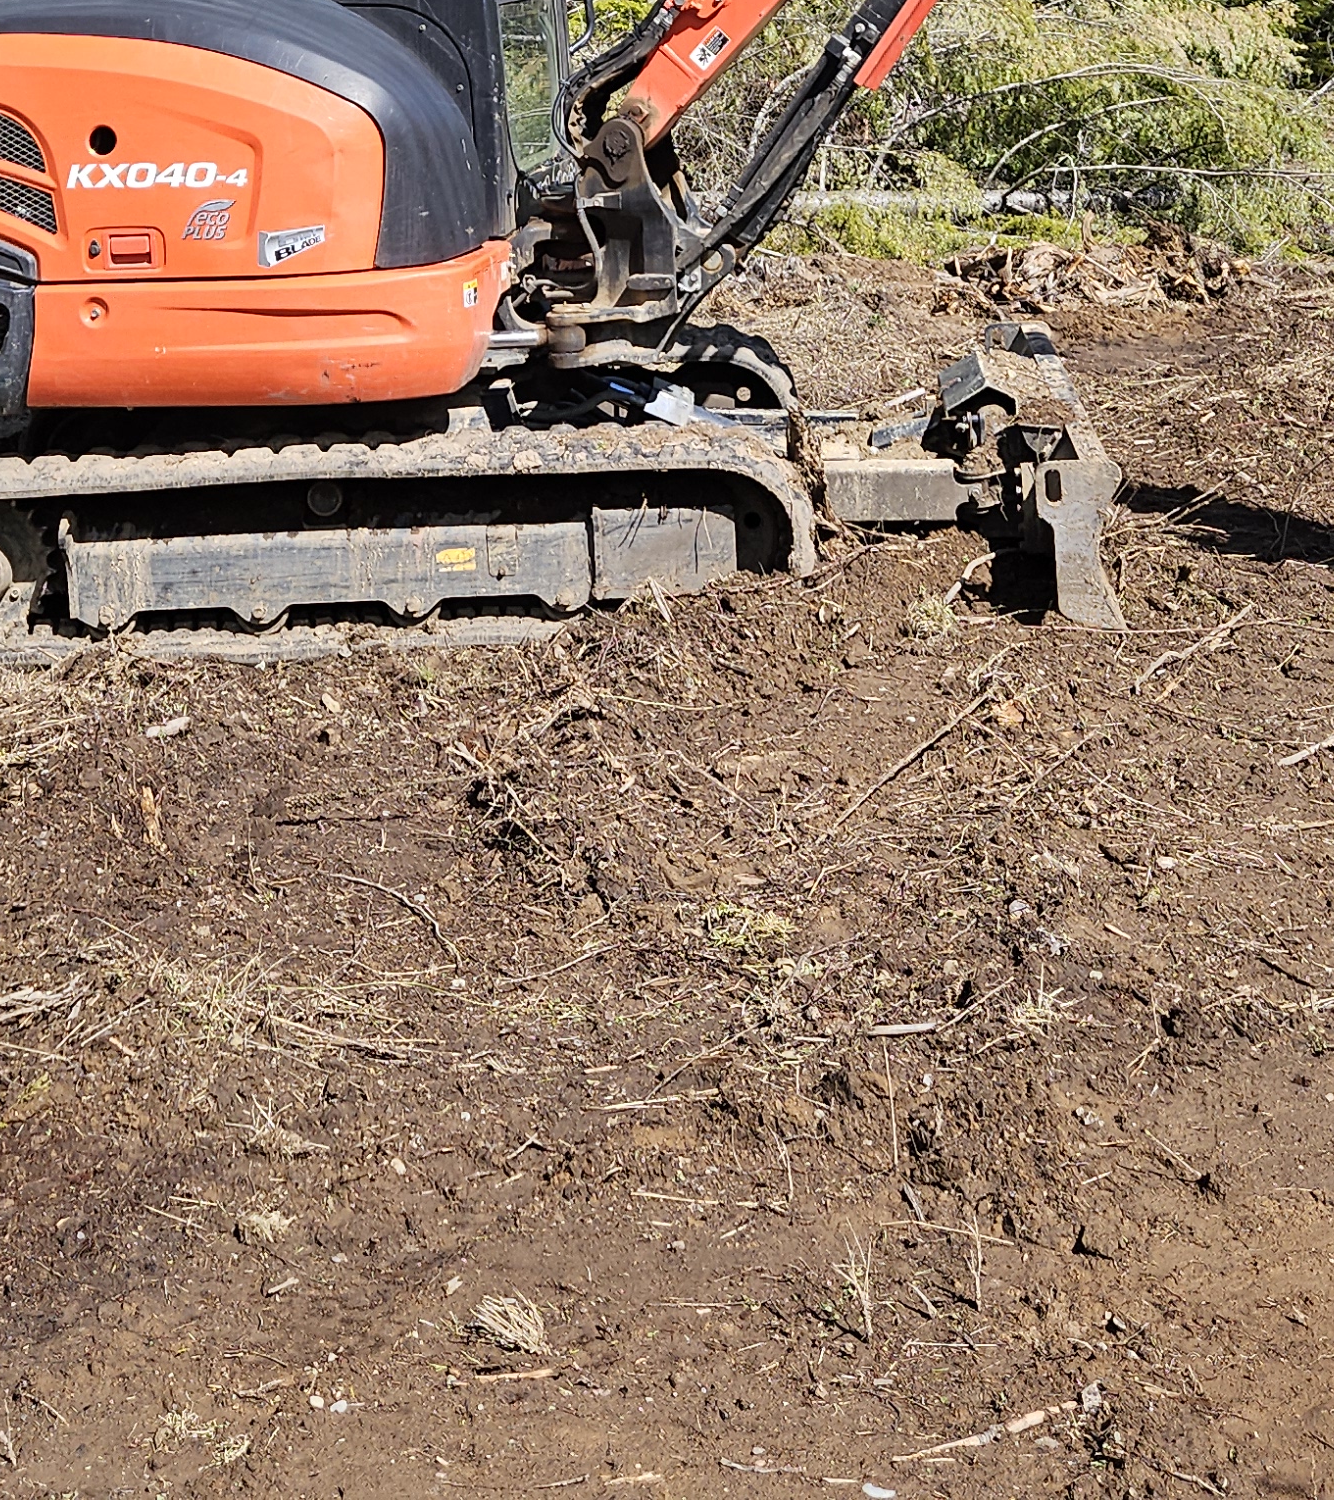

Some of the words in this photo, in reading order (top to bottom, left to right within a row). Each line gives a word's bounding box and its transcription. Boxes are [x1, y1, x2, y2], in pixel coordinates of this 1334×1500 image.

[66, 161, 248, 189] KX040-4
[194, 210, 230, 226] eco
[181, 225, 228, 240] PLUS
[274, 235, 322, 262] BLADE
